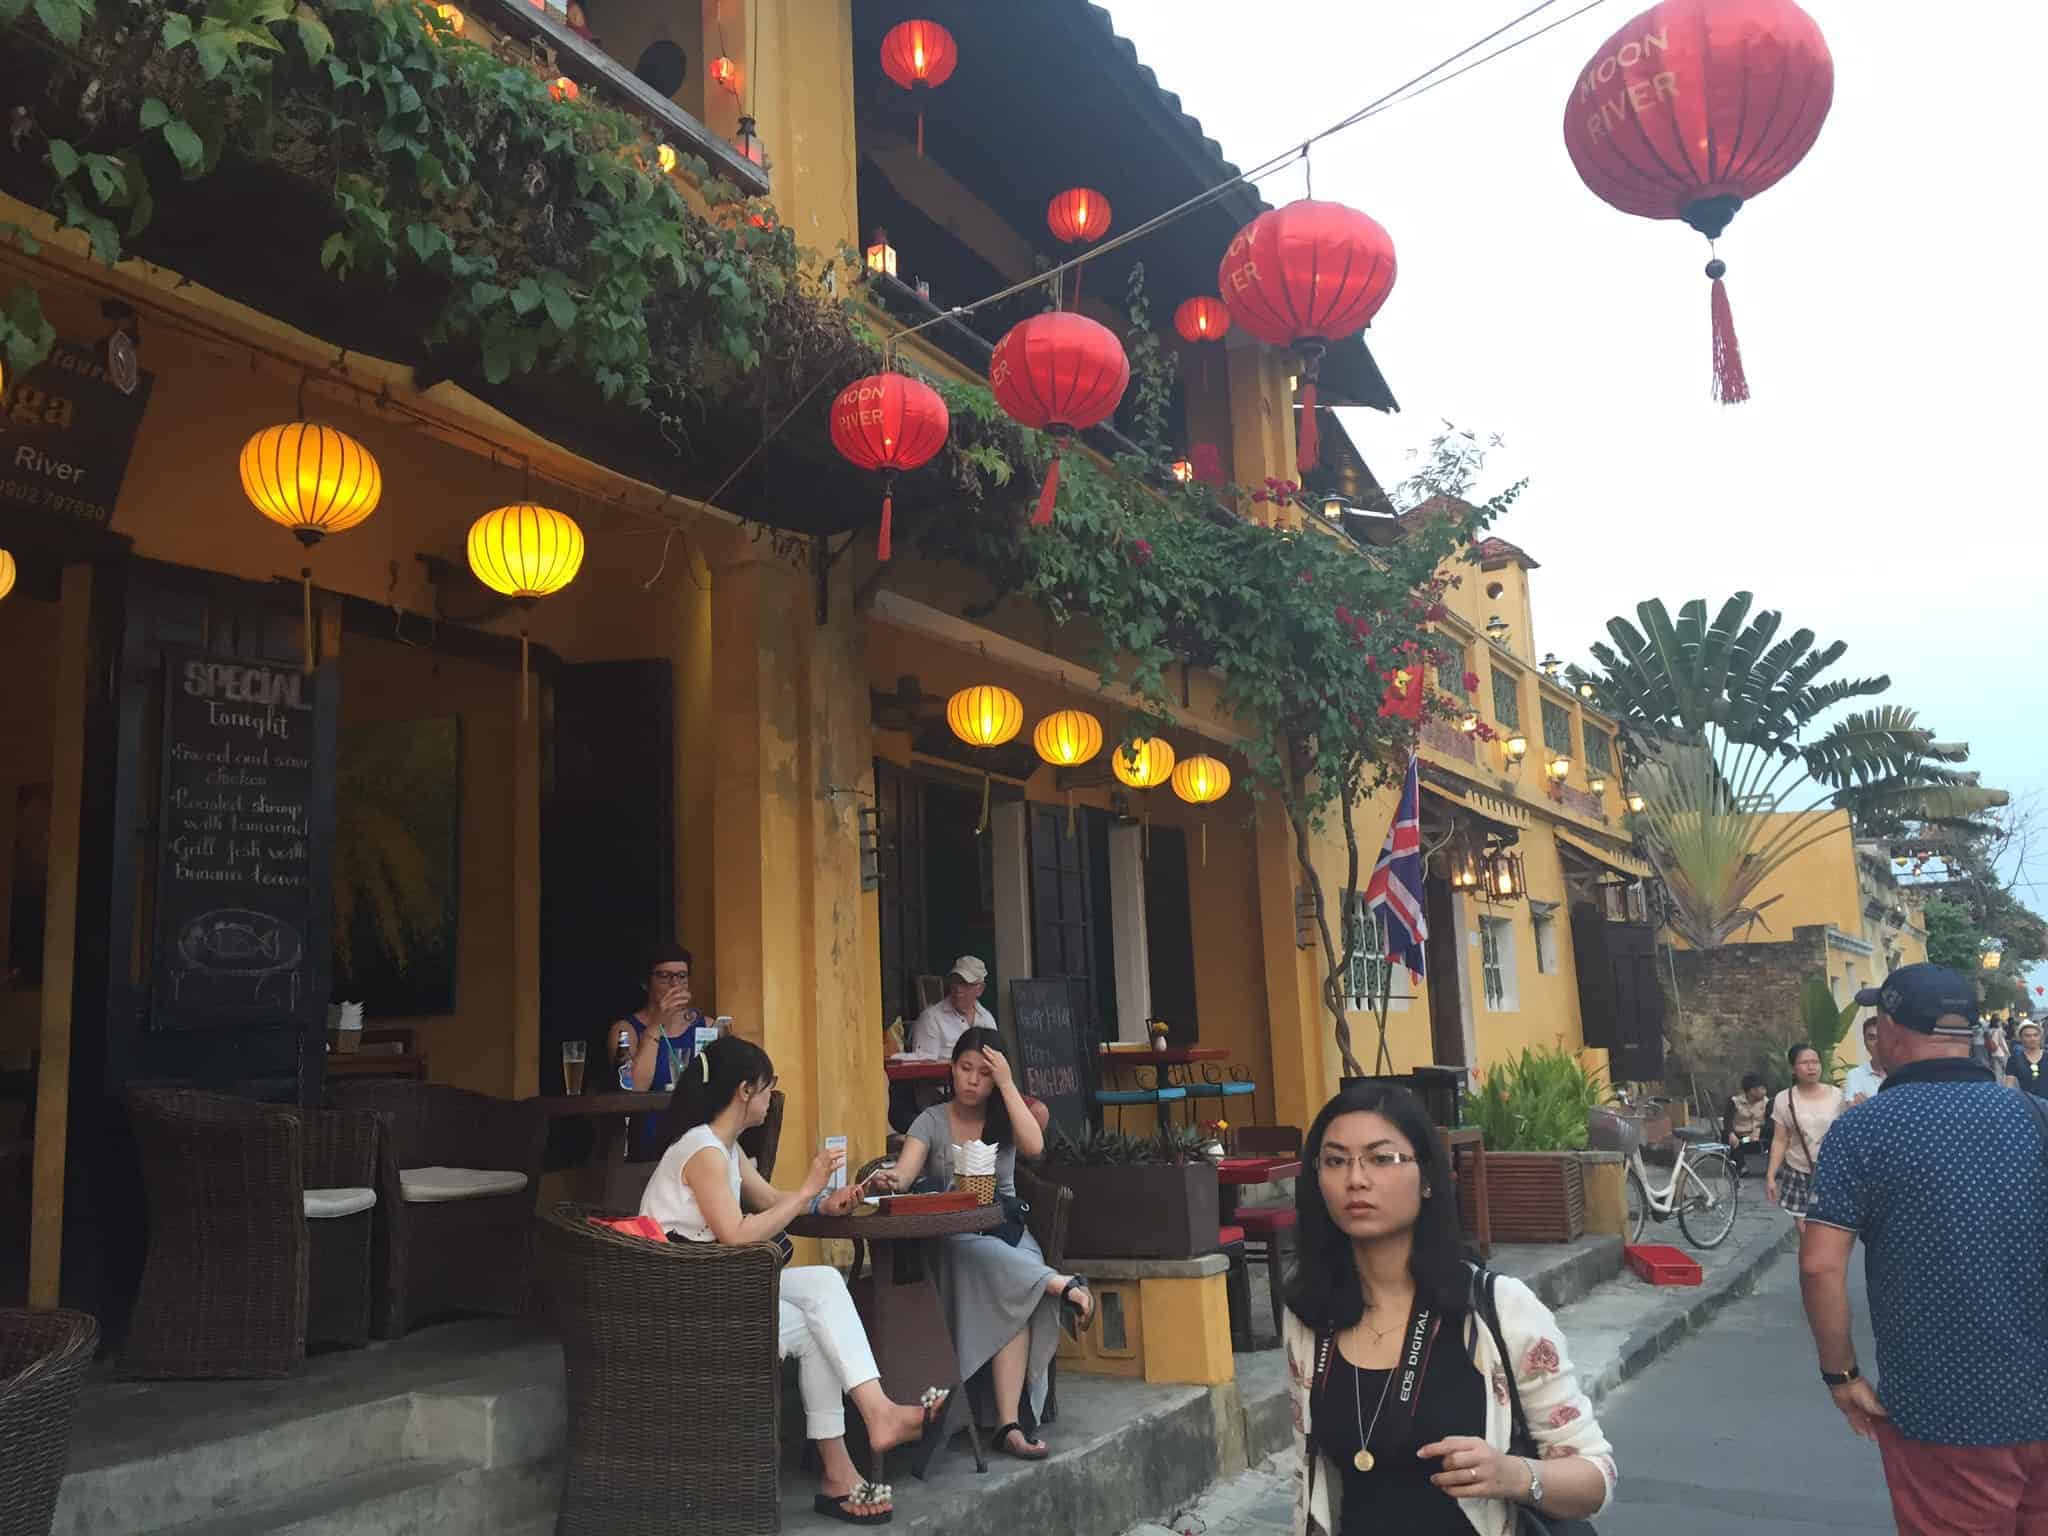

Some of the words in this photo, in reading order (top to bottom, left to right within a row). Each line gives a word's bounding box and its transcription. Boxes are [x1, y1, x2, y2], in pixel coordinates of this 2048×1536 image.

[1578, 25, 1670, 104] MOON
[1587, 72, 1680, 144] RIVER
[15, 445, 88, 486] River
[205, 700, 289, 740] Tonight
[1400, 1370, 1415, 1402] EOS
[1408, 1310, 1430, 1366] DIGITAL
